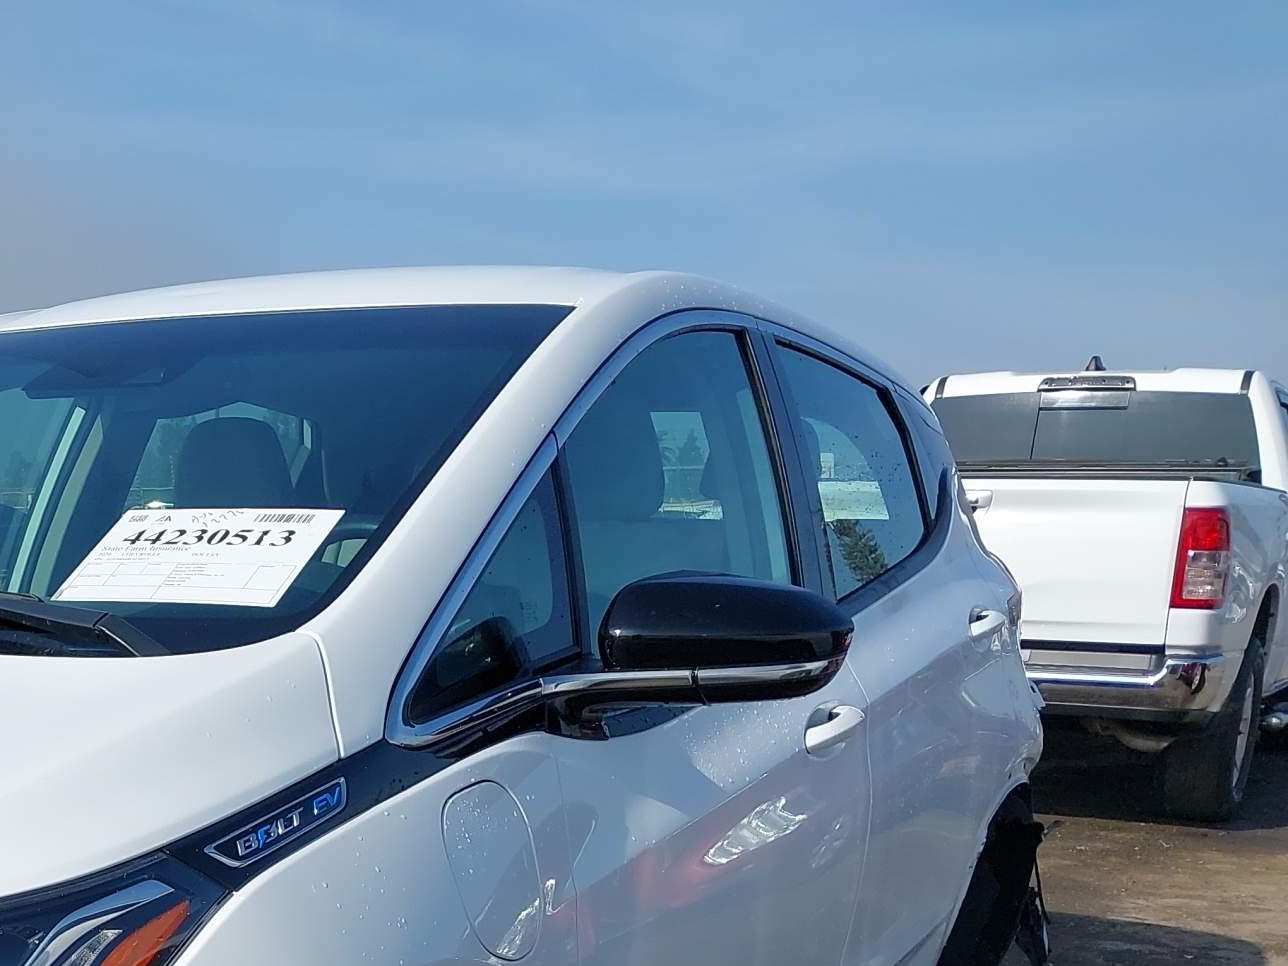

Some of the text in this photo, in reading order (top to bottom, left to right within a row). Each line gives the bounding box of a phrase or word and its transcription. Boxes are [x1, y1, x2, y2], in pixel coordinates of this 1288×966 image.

[122, 528, 296, 547] 44230513
[236, 786, 341, 857] BOLT EV
